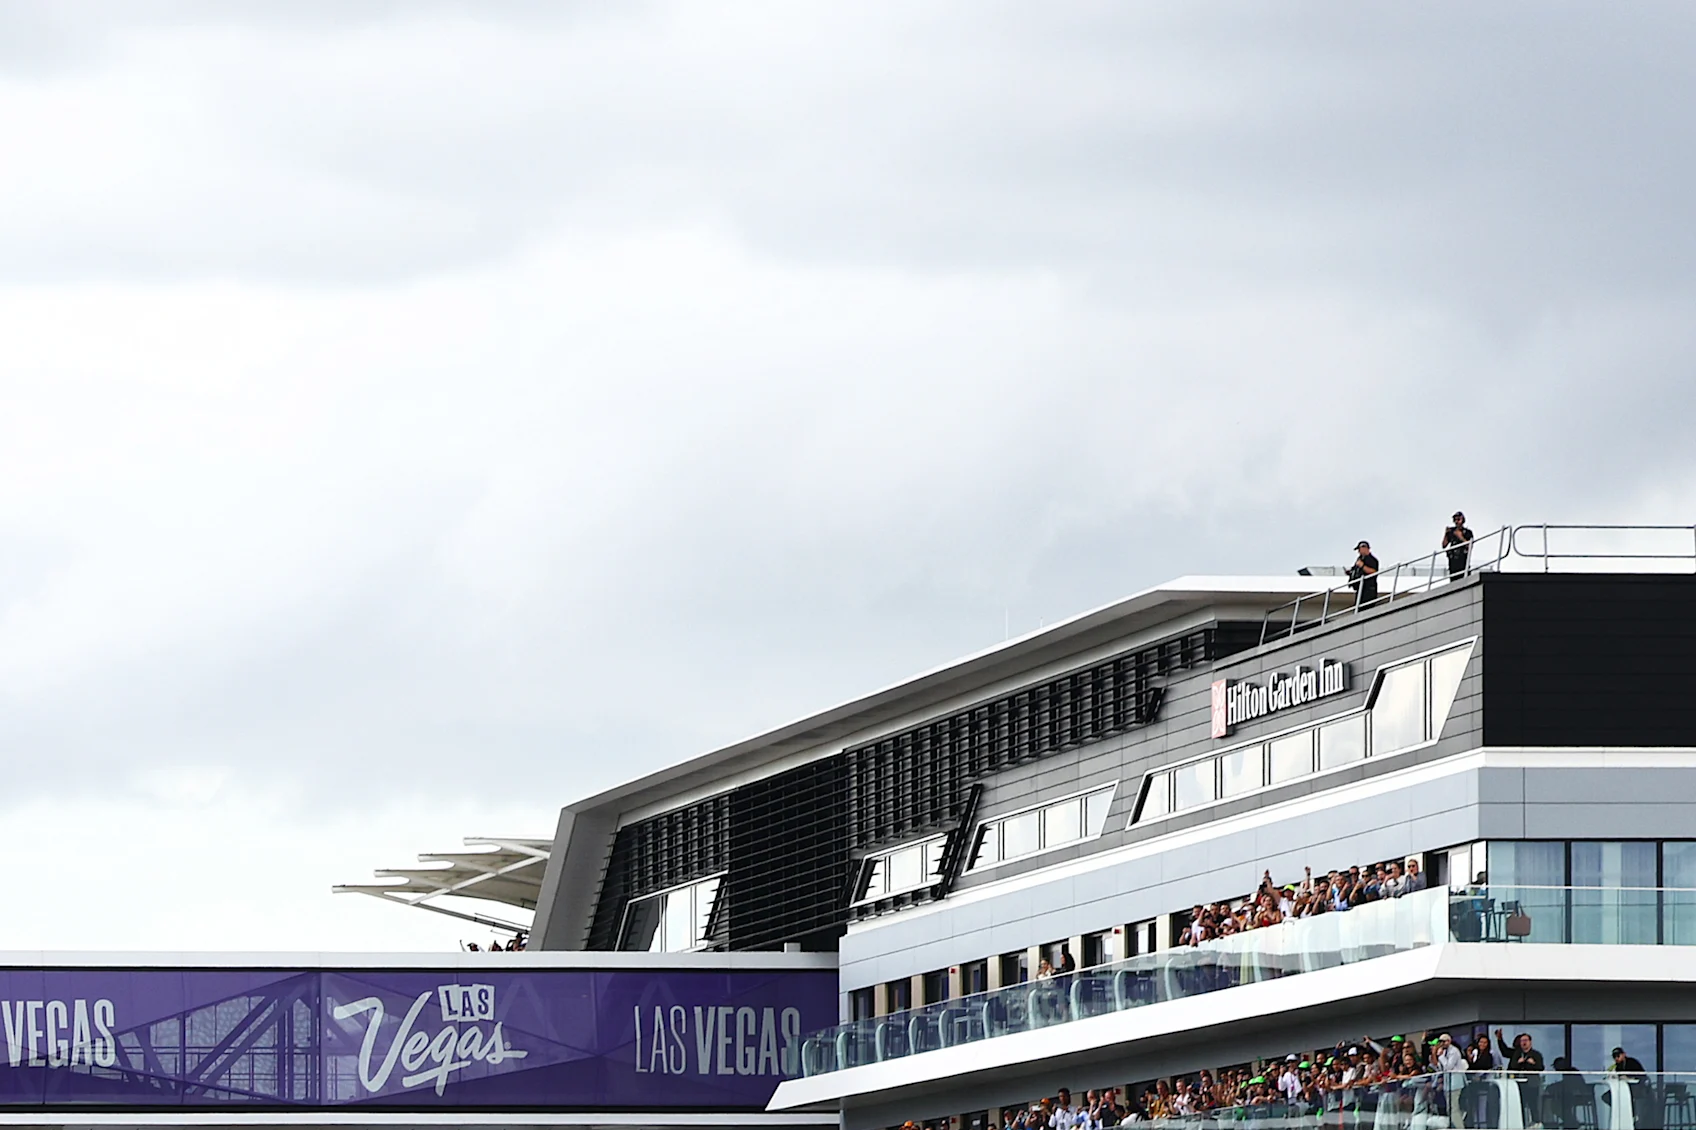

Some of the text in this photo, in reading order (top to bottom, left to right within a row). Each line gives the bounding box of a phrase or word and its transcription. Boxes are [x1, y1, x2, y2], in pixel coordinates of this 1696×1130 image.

[1227, 657, 1345, 726] Hilton Garden Inn
[2, 998, 116, 1069] VEGAS
[444, 987, 492, 1019] LAS
[334, 991, 528, 1096] Vegas
[633, 1005, 800, 1077] LAS VEGAS
